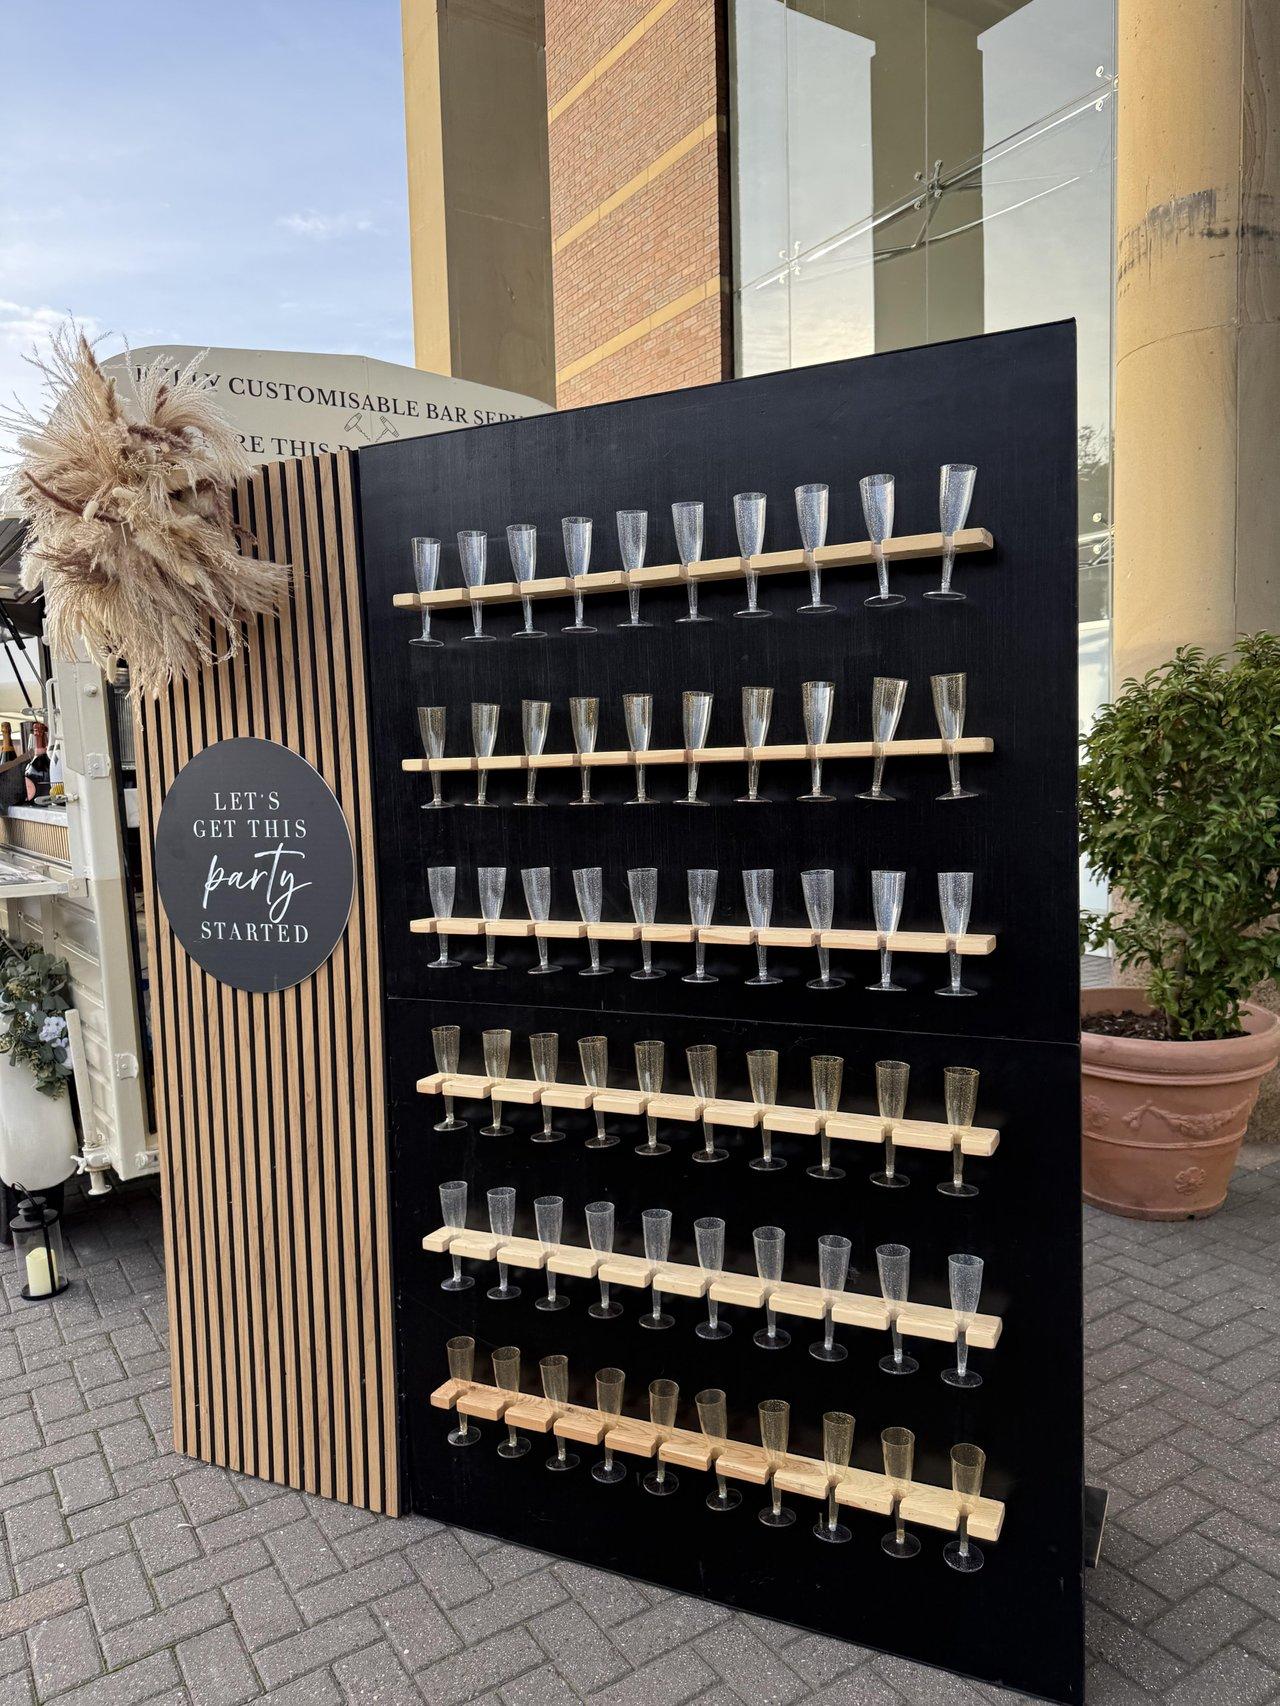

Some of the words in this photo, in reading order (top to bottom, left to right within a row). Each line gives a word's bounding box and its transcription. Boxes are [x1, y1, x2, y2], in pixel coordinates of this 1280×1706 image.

[228, 376, 420, 418] CUSTOMISABLE
[426, 402, 469, 424] BAR
[271, 437, 329, 458] THIS
[213, 791, 280, 811] LET'S
[193, 819, 236, 838] GET
[247, 818, 307, 839] THIS
[202, 842, 313, 923] party
[200, 921, 309, 944] STARTED
